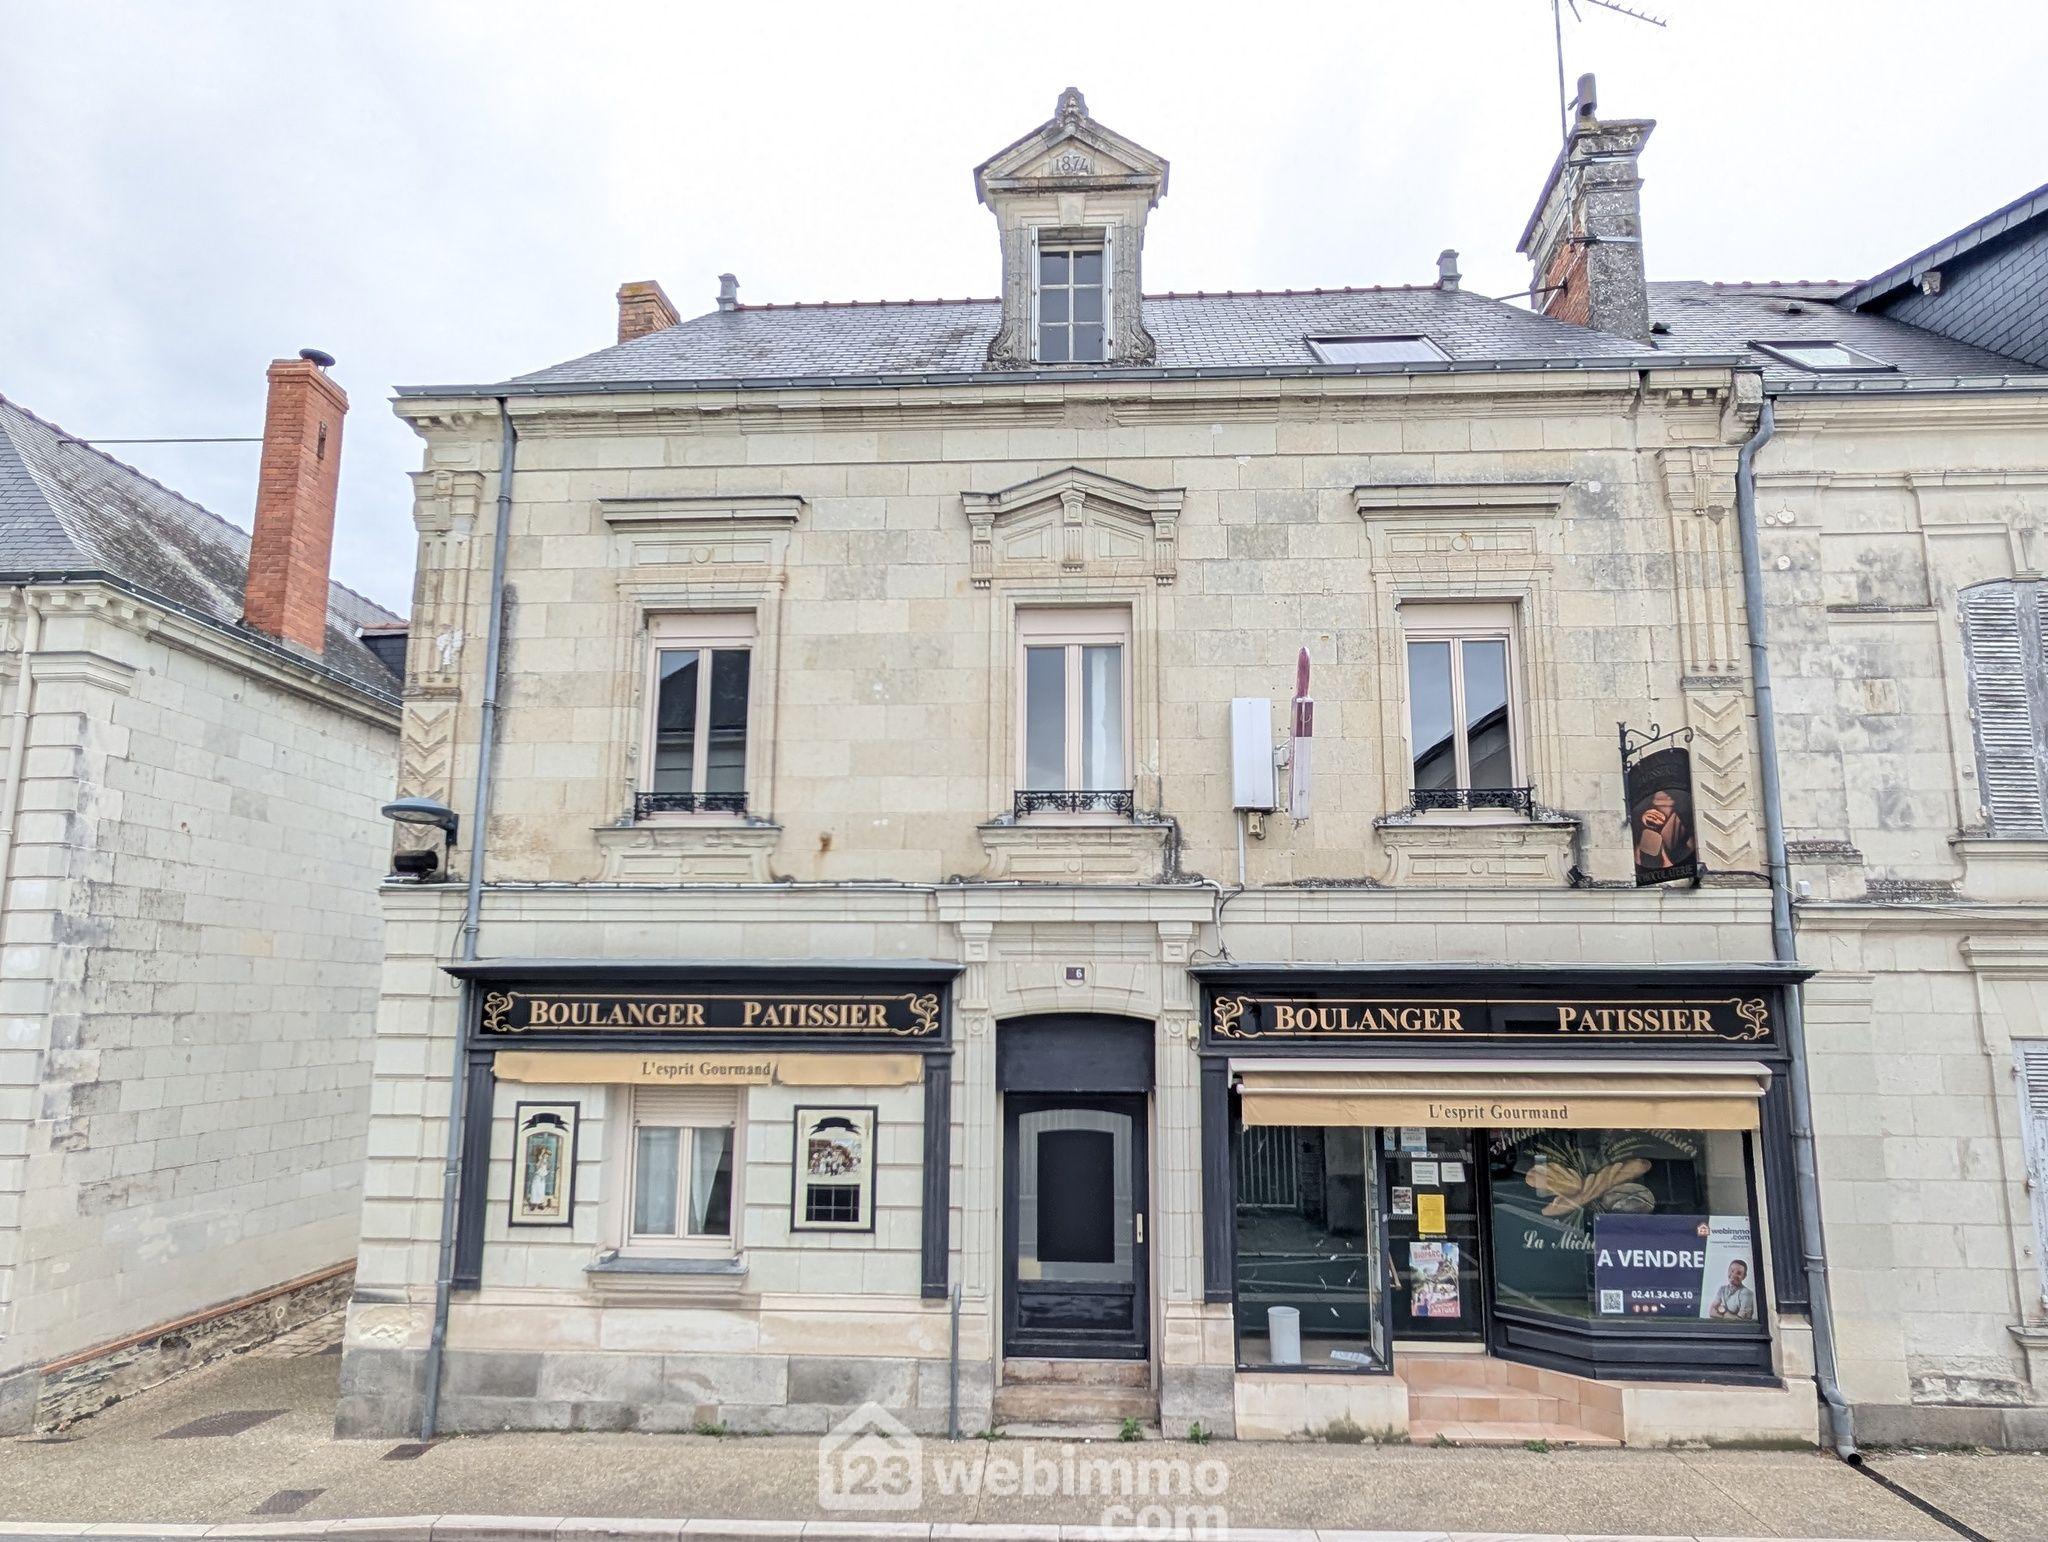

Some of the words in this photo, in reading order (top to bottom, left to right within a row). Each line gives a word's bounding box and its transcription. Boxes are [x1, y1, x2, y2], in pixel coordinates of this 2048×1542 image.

[1056, 155, 1089, 172] 1874
[529, 1000, 705, 1025] BOULANGER
[742, 1001, 889, 1027] PATISSIER
[1274, 1005, 1465, 1031] BOULANGER
[1556, 1007, 1715, 1032] PATISSIER
[642, 1062, 694, 1079] L'esprit
[700, 1062, 771, 1076] Gourmand
[1429, 1104, 1484, 1121] L'esprit
[1491, 1104, 1568, 1119] Gourmand
[1711, 1227, 1750, 1235] webimmo
[1597, 1249, 1613, 1267] A
[1617, 1249, 1705, 1268] VENDRE
[1631, 1290, 1693, 1299] 02.41.34.49.10
